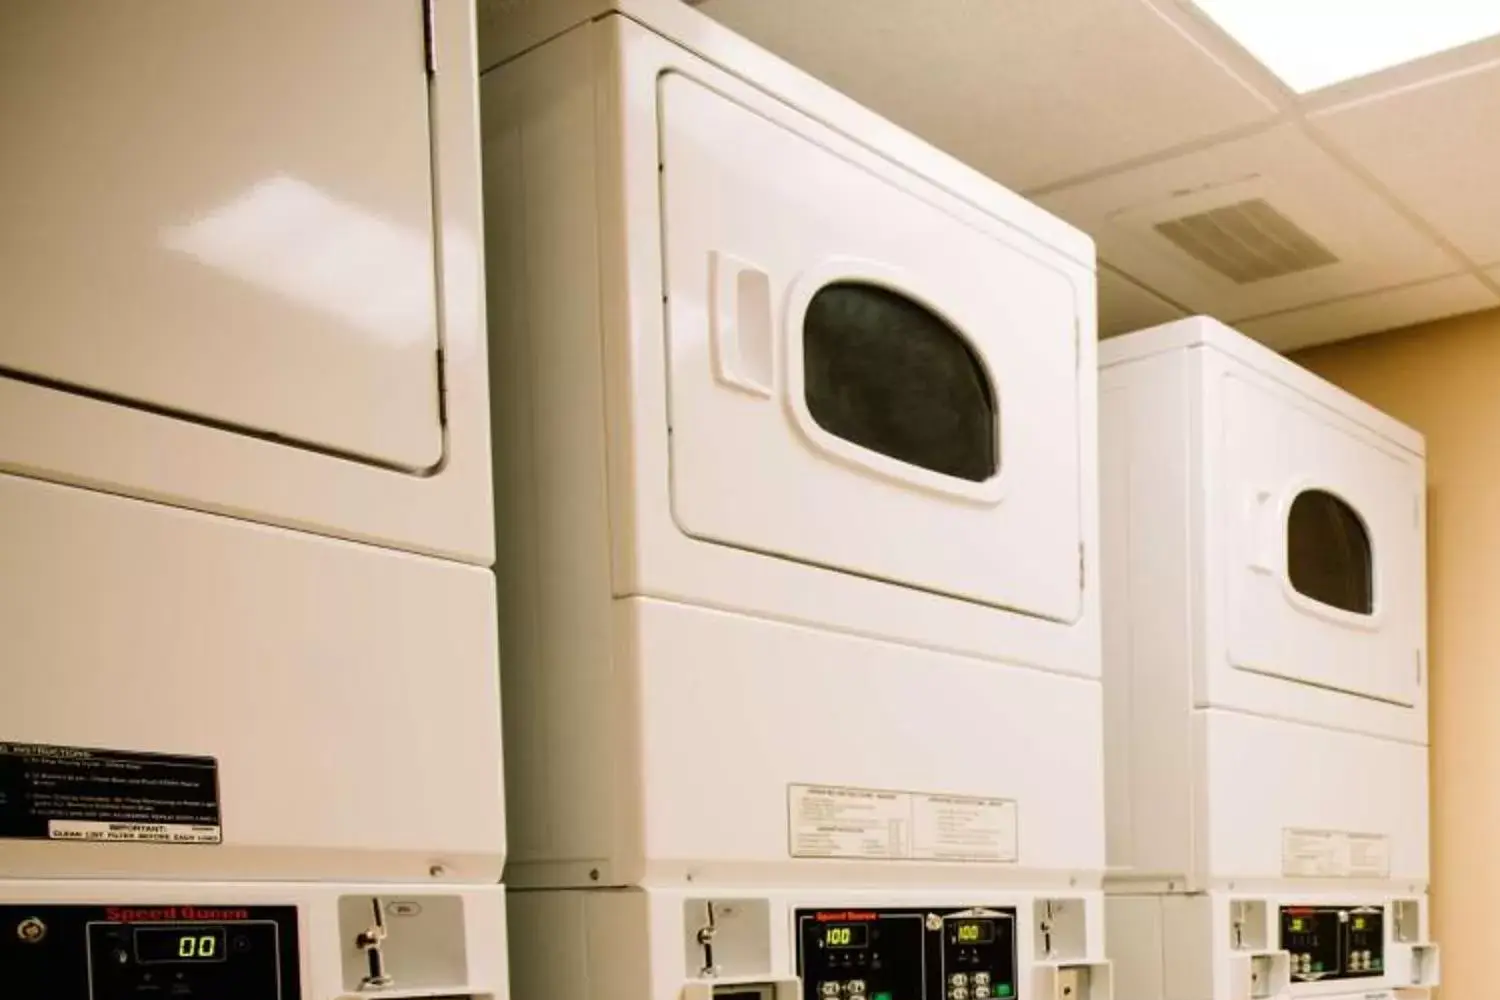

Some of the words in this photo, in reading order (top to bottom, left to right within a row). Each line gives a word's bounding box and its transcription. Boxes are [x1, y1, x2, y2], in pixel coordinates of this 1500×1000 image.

[107, 907, 178, 921] Speed
[181, 906, 249, 920] Queen
[827, 928, 851, 945] 100
[179, 936, 216, 957] 00
